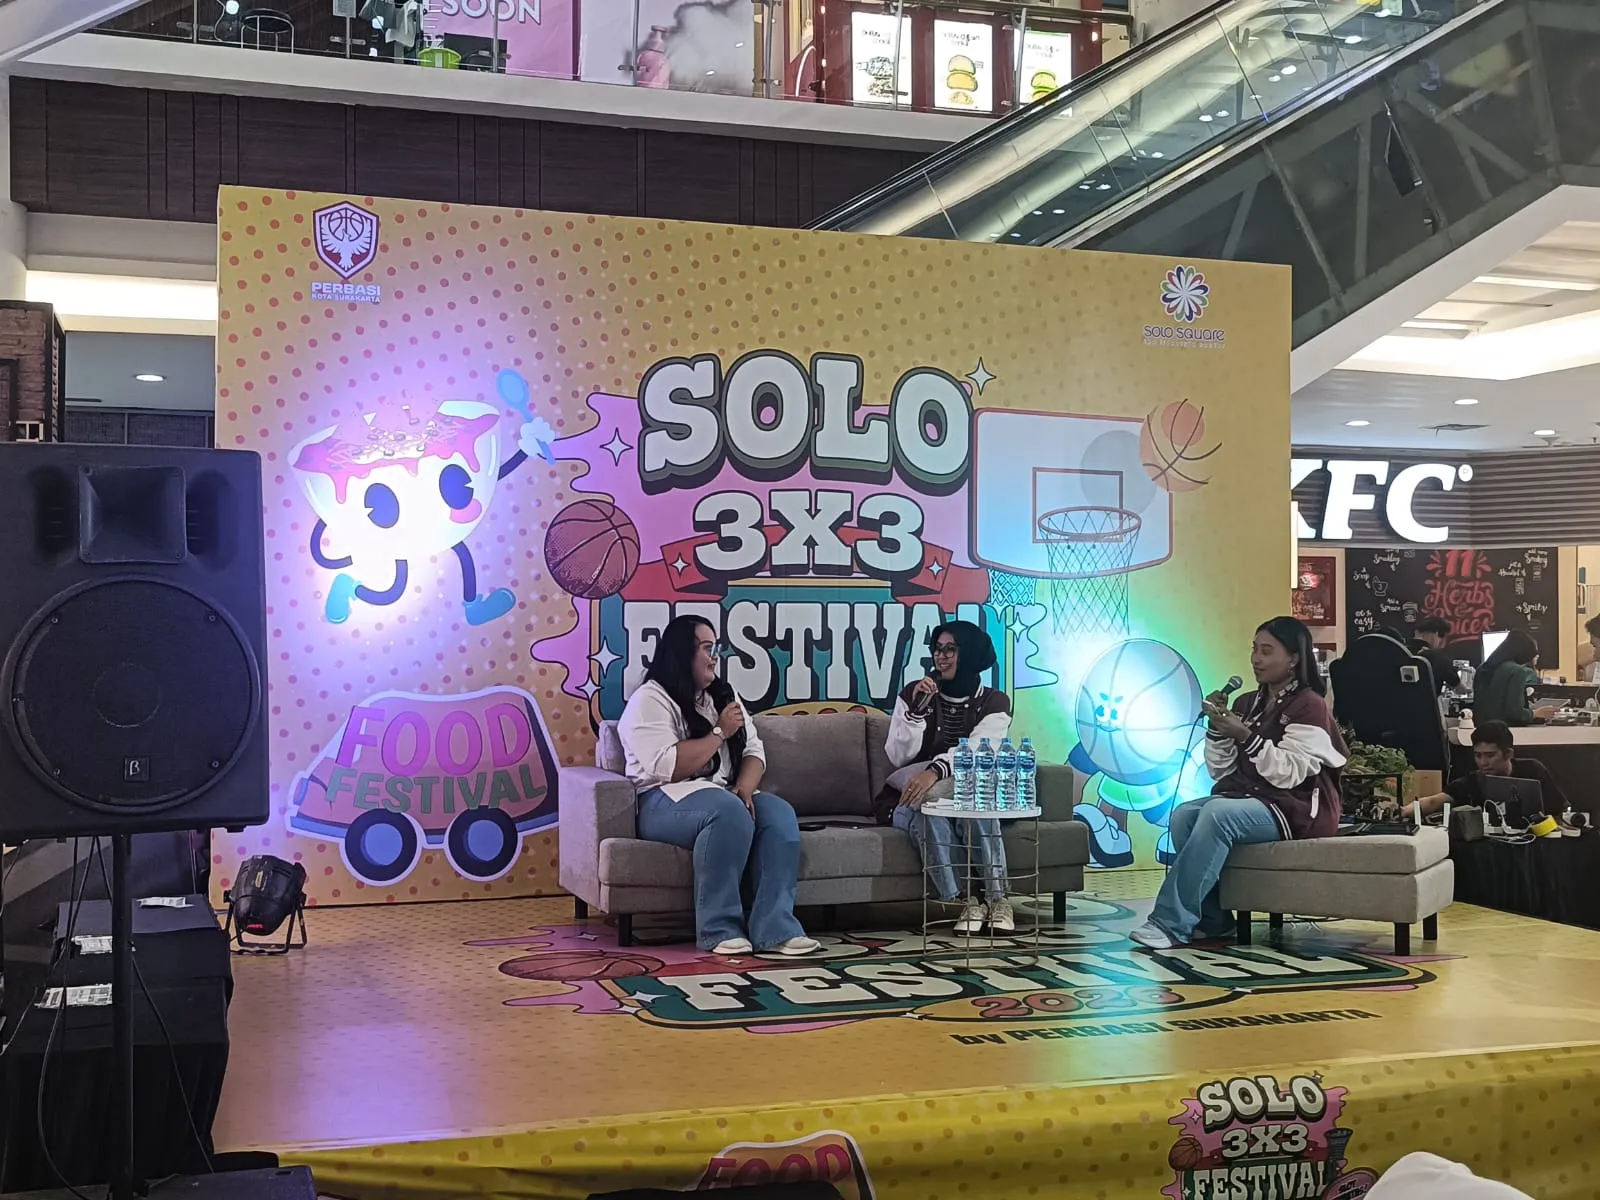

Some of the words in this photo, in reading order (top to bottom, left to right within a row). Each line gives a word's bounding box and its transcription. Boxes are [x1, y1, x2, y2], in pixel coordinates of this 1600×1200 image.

[442, 0, 541, 25] SOON
[311, 282, 381, 296] PERBASI
[640, 351, 974, 492] SOLO
[694, 490, 923, 576] 3X3
[1424, 580, 1494, 616] Herbs
[335, 702, 531, 776] FOOD
[324, 763, 548, 814] FESTIVAL
[657, 946, 1371, 1010] FESTIVAL
[949, 1032, 1006, 1046] by
[1003, 1021, 1173, 1042] PERBASI
[1167, 1008, 1383, 1031] SURAKARTA
[1199, 1076, 1327, 1133] SOLO
[1222, 1123, 1308, 1160] 3X3
[1192, 1160, 1329, 1200] FESTIVAL
